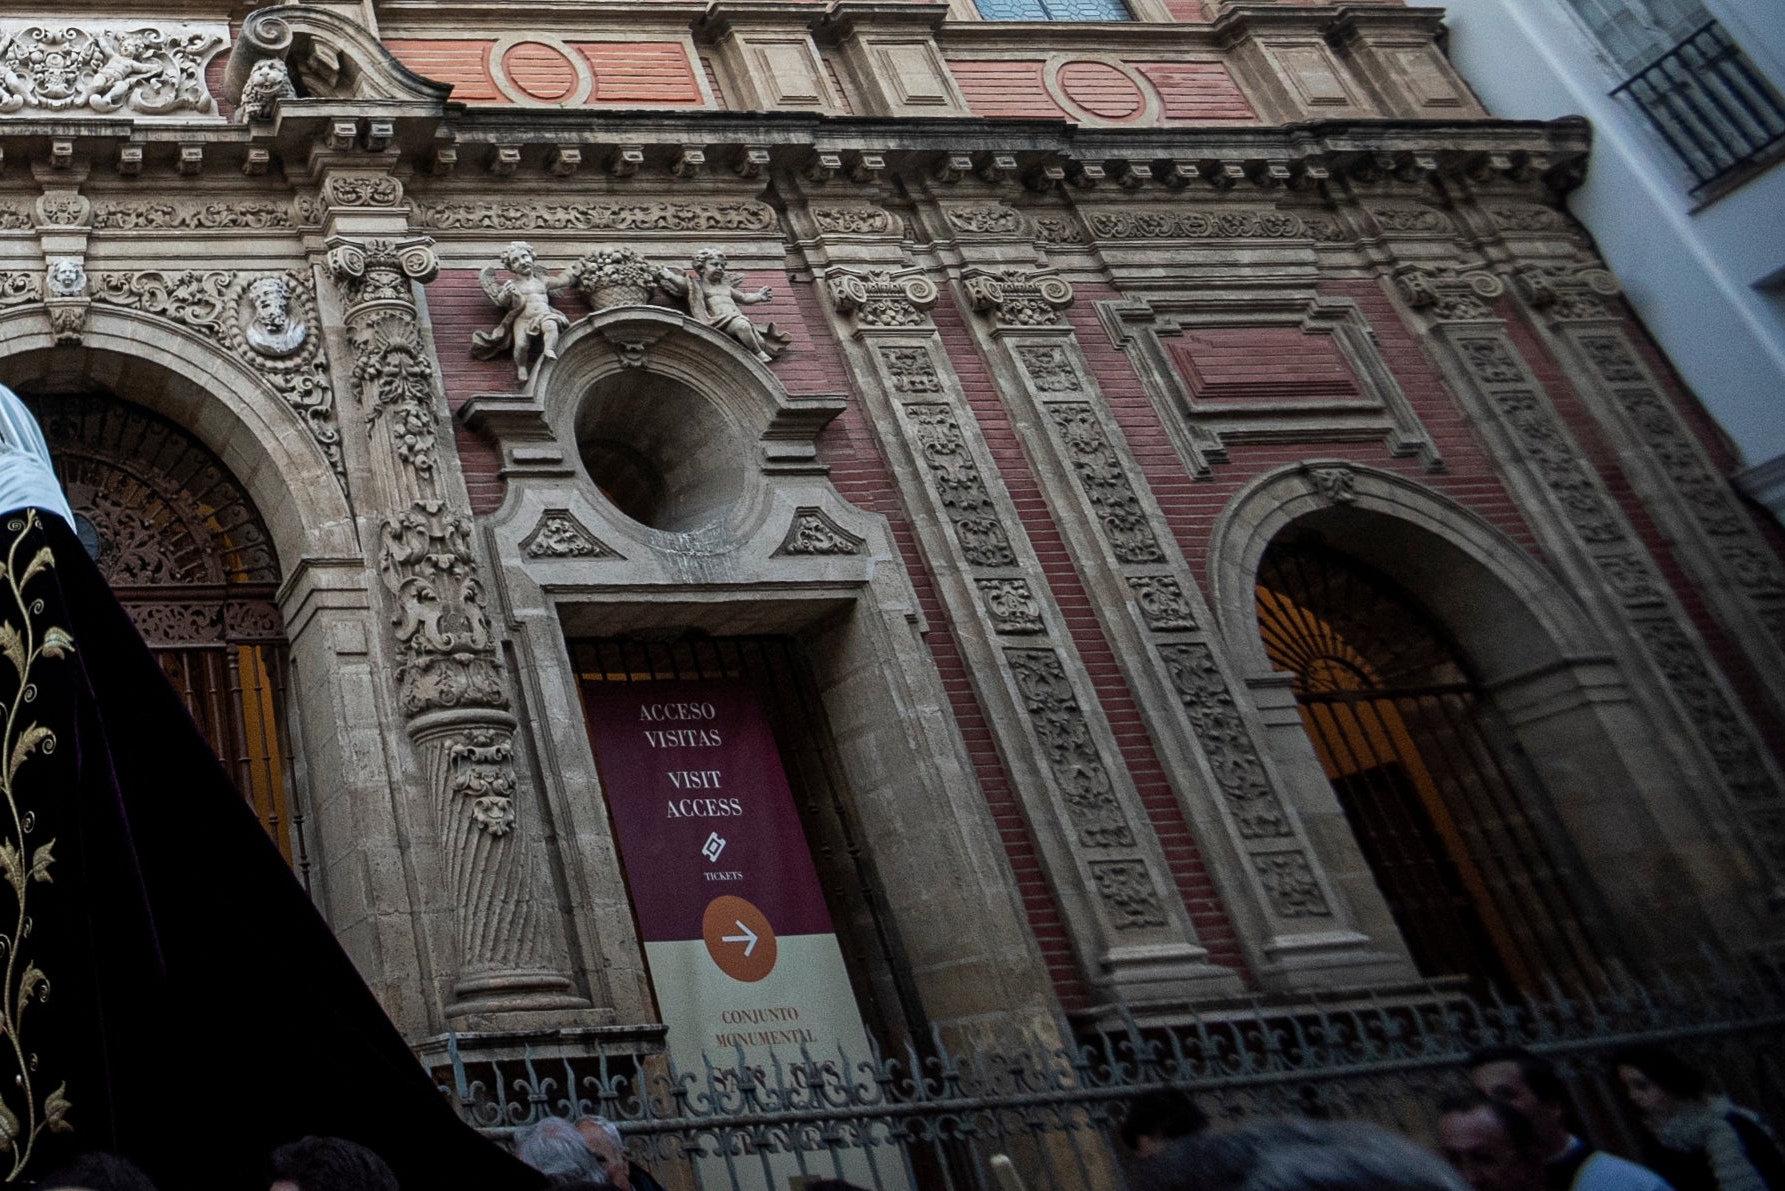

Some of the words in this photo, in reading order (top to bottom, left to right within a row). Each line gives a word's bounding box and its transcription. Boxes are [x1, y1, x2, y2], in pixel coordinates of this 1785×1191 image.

[640, 703, 715, 721] ACCESO
[644, 729, 722, 748] VISITAS
[667, 770, 722, 790] VISIT
[666, 798, 743, 818] ACCESS
[704, 871, 743, 881] TICKETS
[722, 1007, 799, 1025] CONJUNTO
[716, 1029, 817, 1047] MONUMENTL
